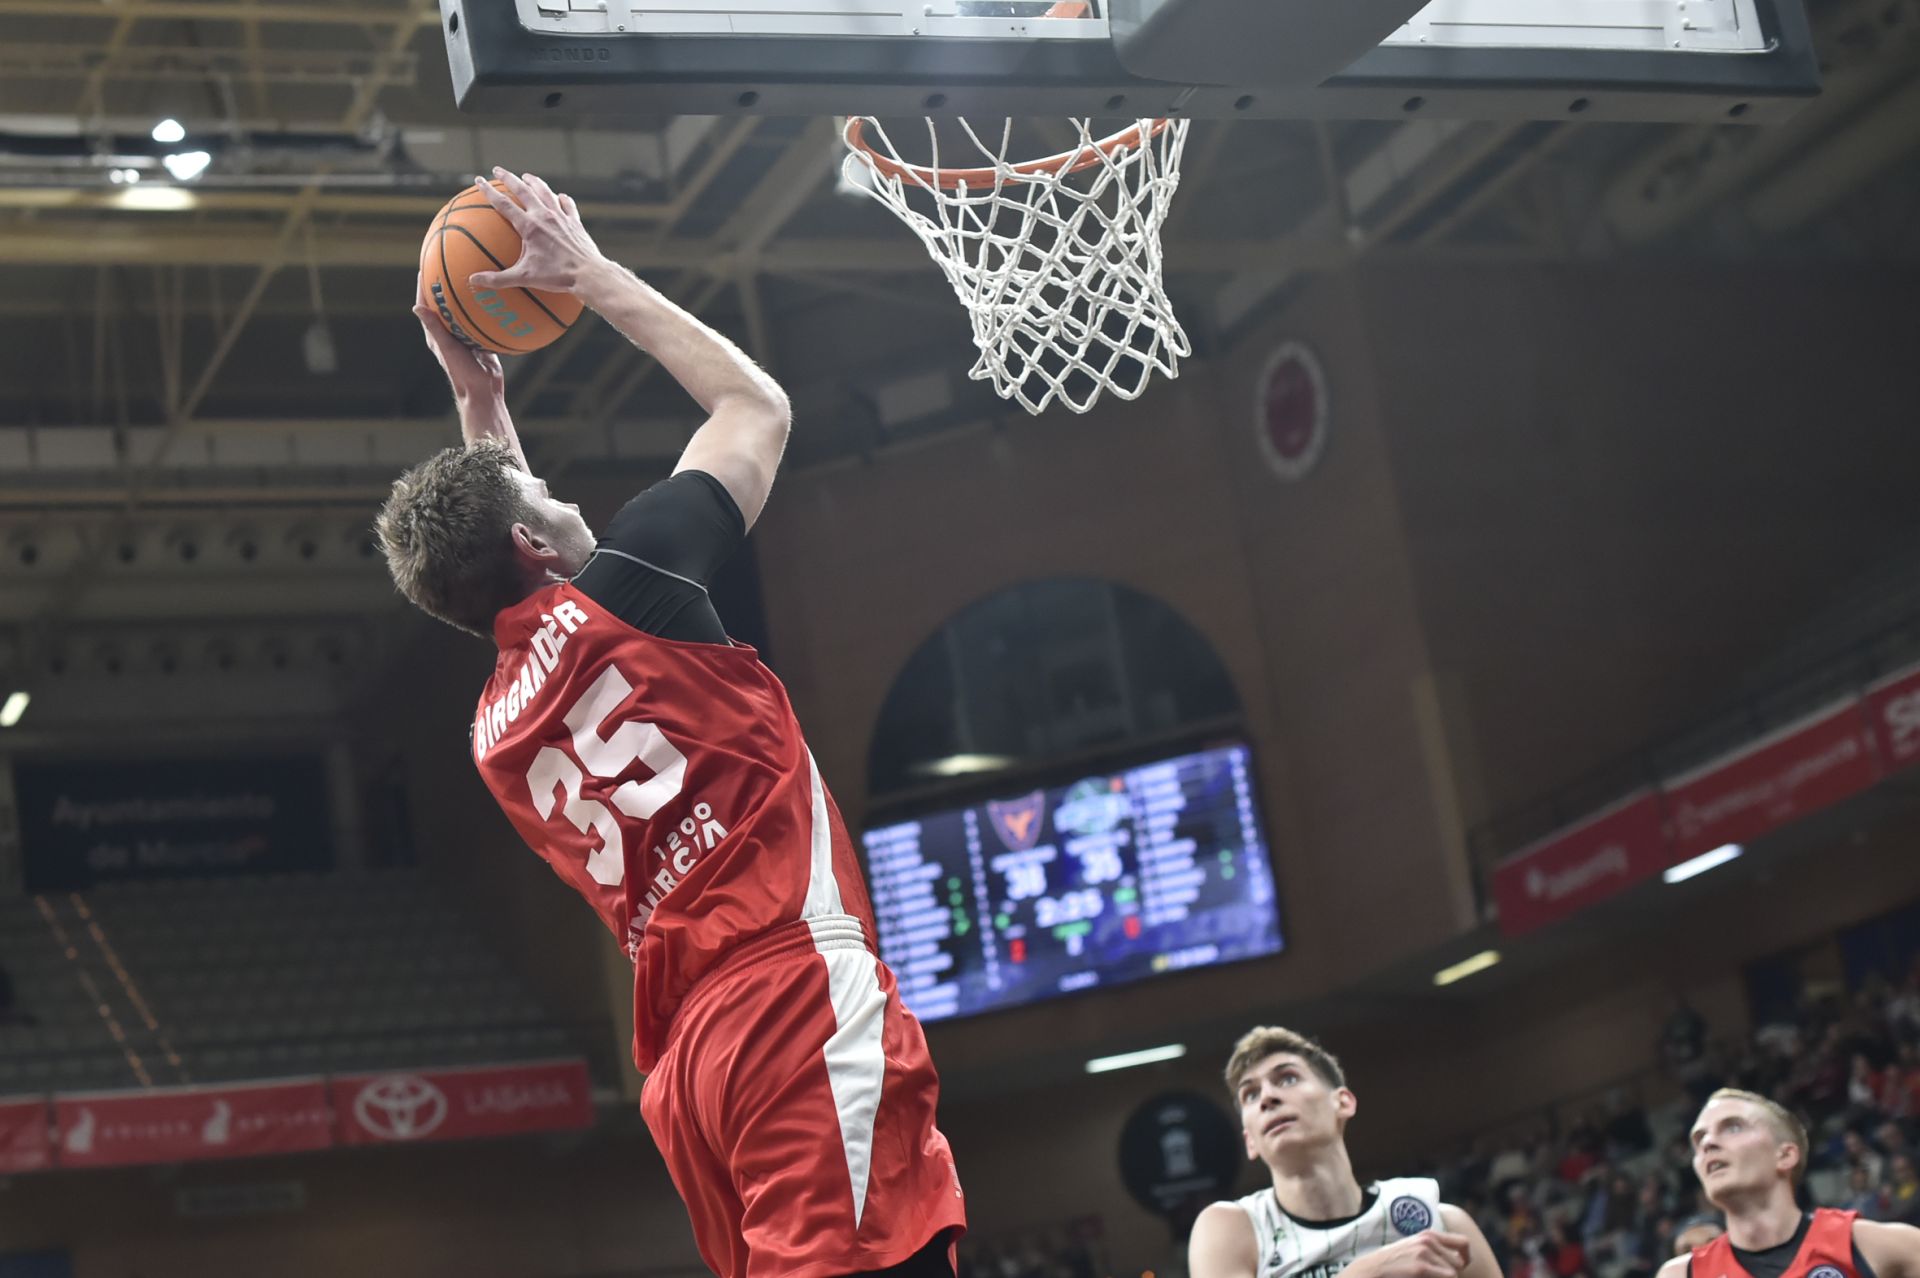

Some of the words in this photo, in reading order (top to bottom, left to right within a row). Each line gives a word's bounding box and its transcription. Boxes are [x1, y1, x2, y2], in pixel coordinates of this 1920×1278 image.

[529, 47, 611, 62] MONDO
[474, 600, 589, 762] BIRGANDER
[526, 663, 688, 887] 35
[653, 802, 712, 861] 1200
